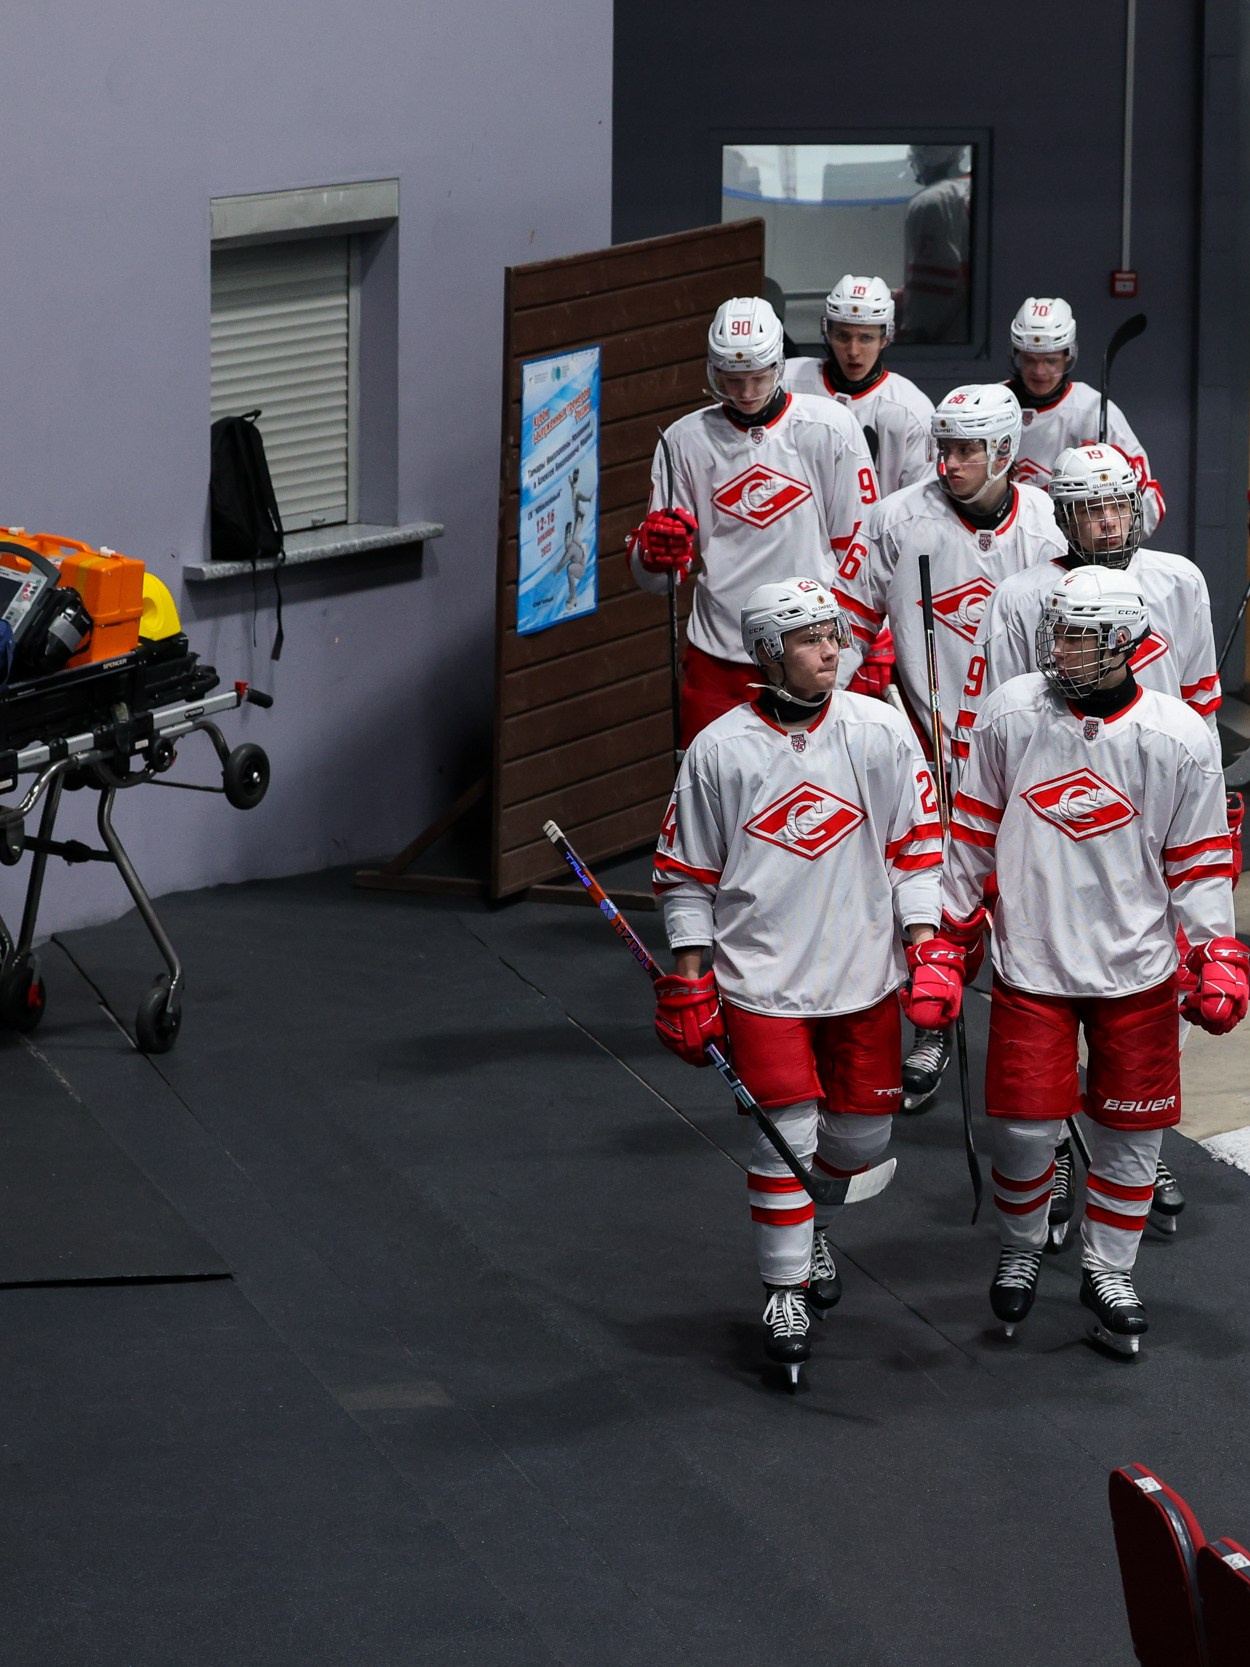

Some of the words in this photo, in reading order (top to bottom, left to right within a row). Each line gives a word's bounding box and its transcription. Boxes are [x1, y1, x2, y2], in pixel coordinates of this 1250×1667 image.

[1031, 305, 1049, 317] 70
[731, 320, 751, 336] 90
[1084, 450, 1104, 460] 19
[857, 467, 878, 504] 9
[837, 542, 868, 580] 6
[811, 603, 834, 613] OLIMPBET
[748, 626, 765, 635] CCM
[102, 658, 128, 670] SPENCER
[963, 655, 987, 697] 9
[915, 769, 938, 814] 2
[565, 851, 592, 888] TRUE
[1102, 1095, 1176, 1113] BAUER
